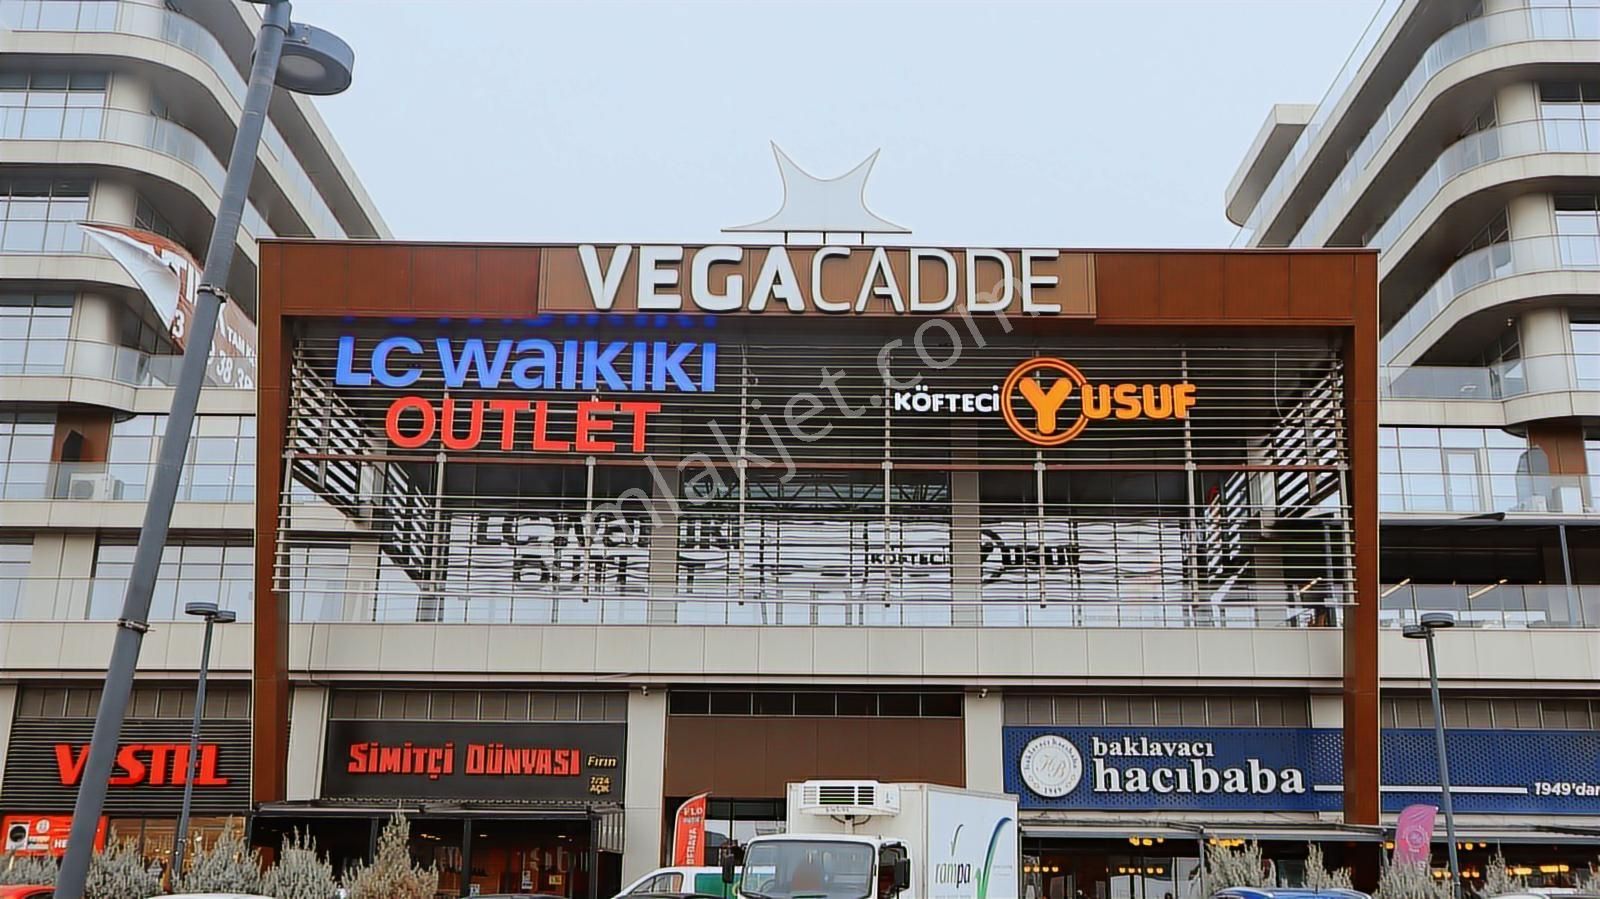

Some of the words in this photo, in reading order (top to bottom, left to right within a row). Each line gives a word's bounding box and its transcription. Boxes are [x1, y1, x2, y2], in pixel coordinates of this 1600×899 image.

[336, 336, 424, 388] LC
[386, 396, 661, 454] OUTLET
[894, 385, 1000, 413] KÖFTECİ
[1018, 377, 1197, 435] YUSUF
[54, 743, 229, 787] VSTEL
[466, 743, 581, 776] DÜNYASI
[1092, 737, 1214, 757] baklavacı
[1092, 758, 1306, 795] hacıbaba
